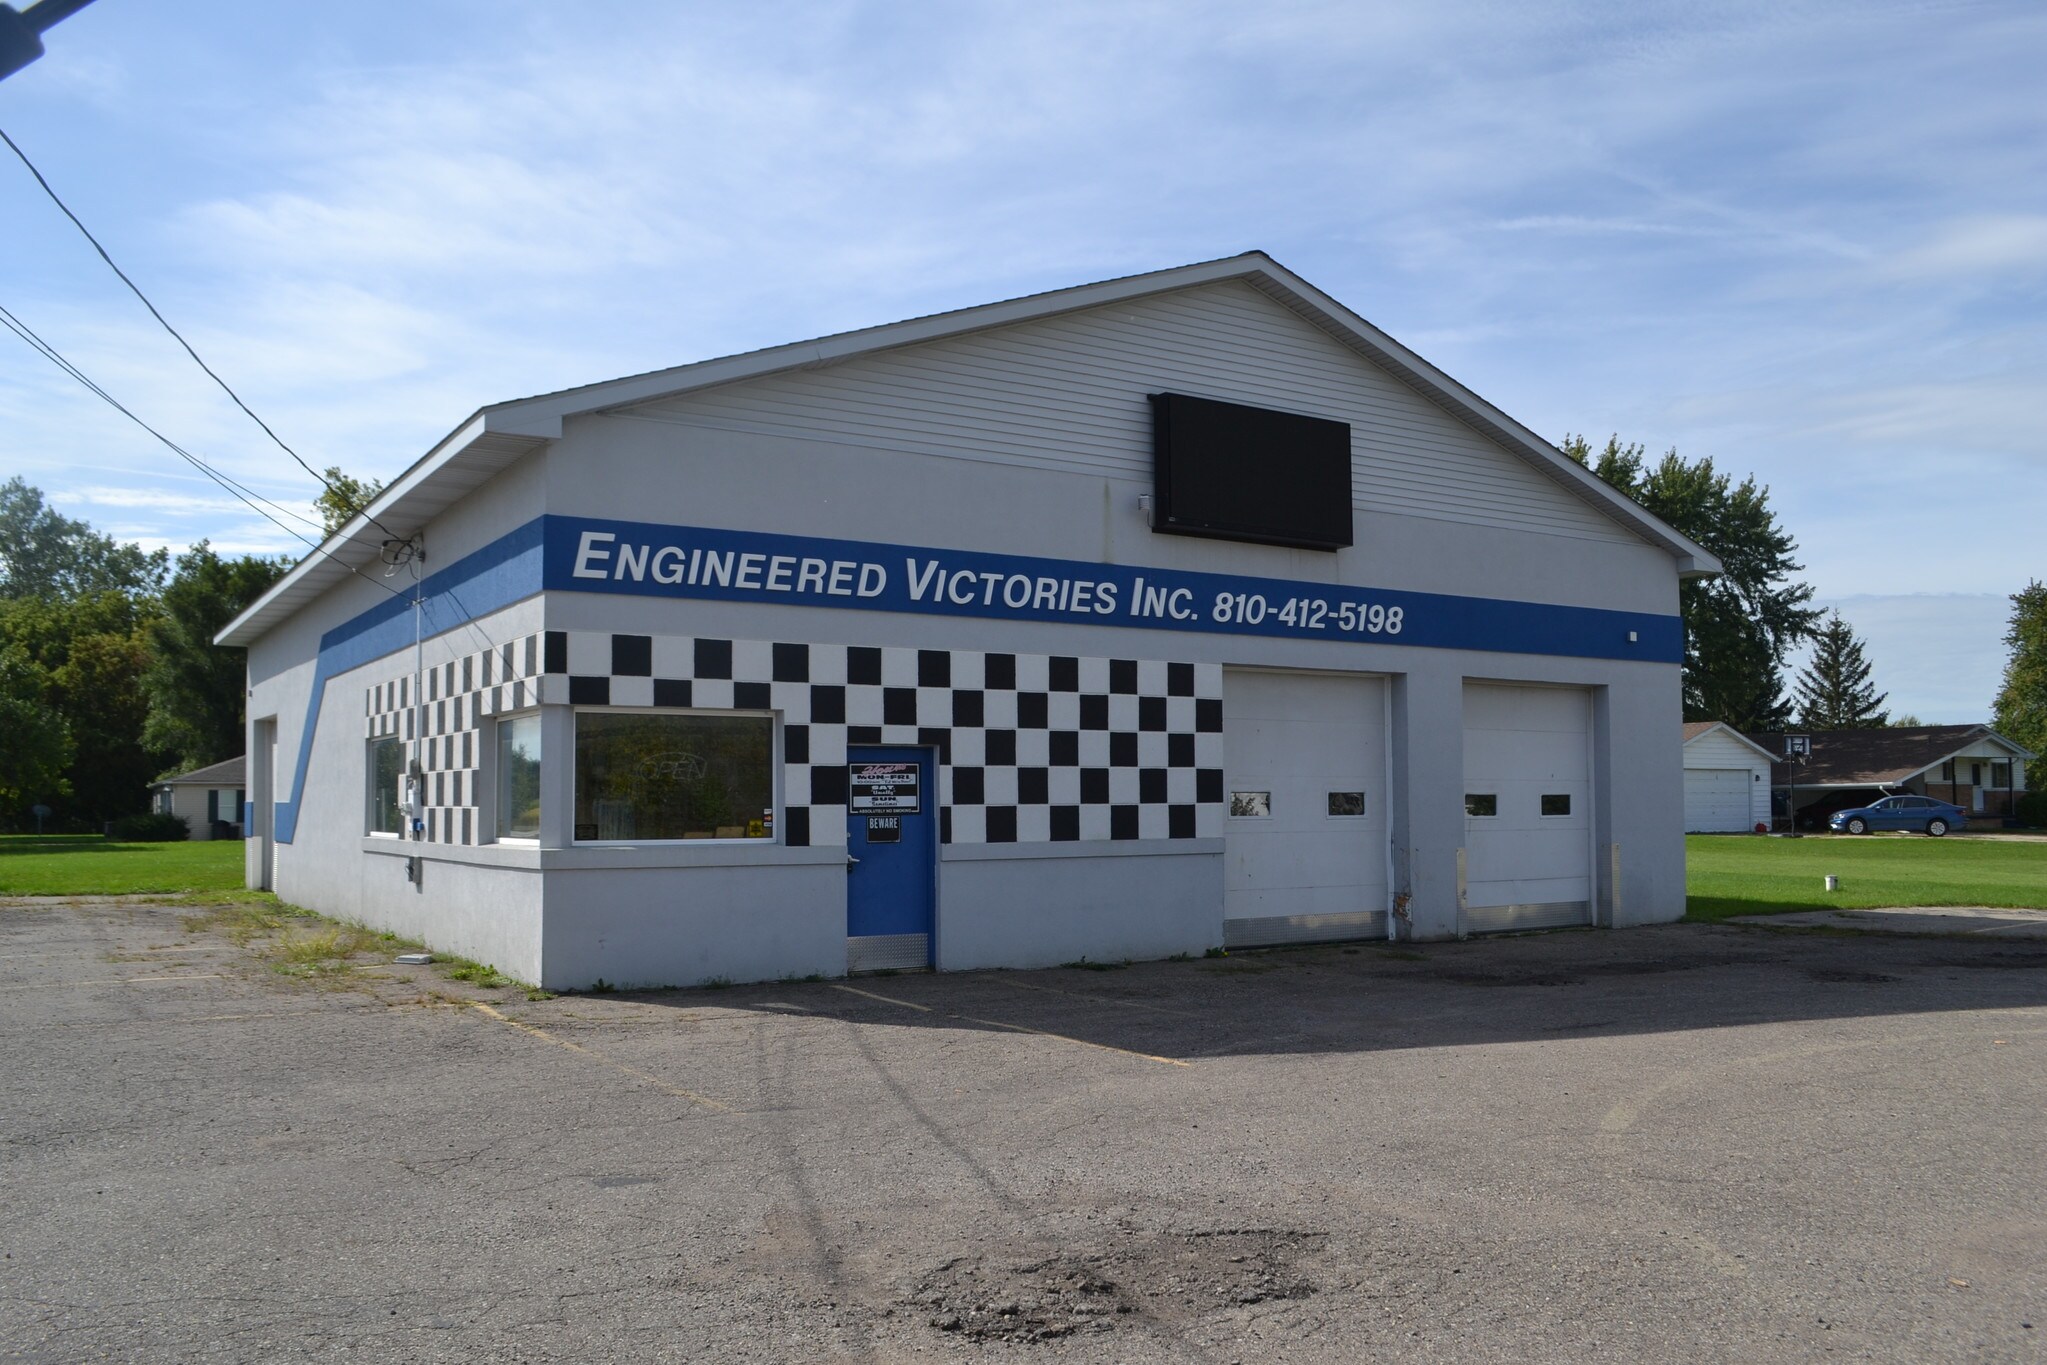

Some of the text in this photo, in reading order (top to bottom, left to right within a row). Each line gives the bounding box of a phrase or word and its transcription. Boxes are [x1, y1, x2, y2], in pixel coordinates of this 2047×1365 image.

[572, 531, 1404, 634] ENGINEERED VICTORIES INC. 810-412-5198
[640, 760, 707, 782] OPEN
[869, 818, 898, 829] BEWARE
